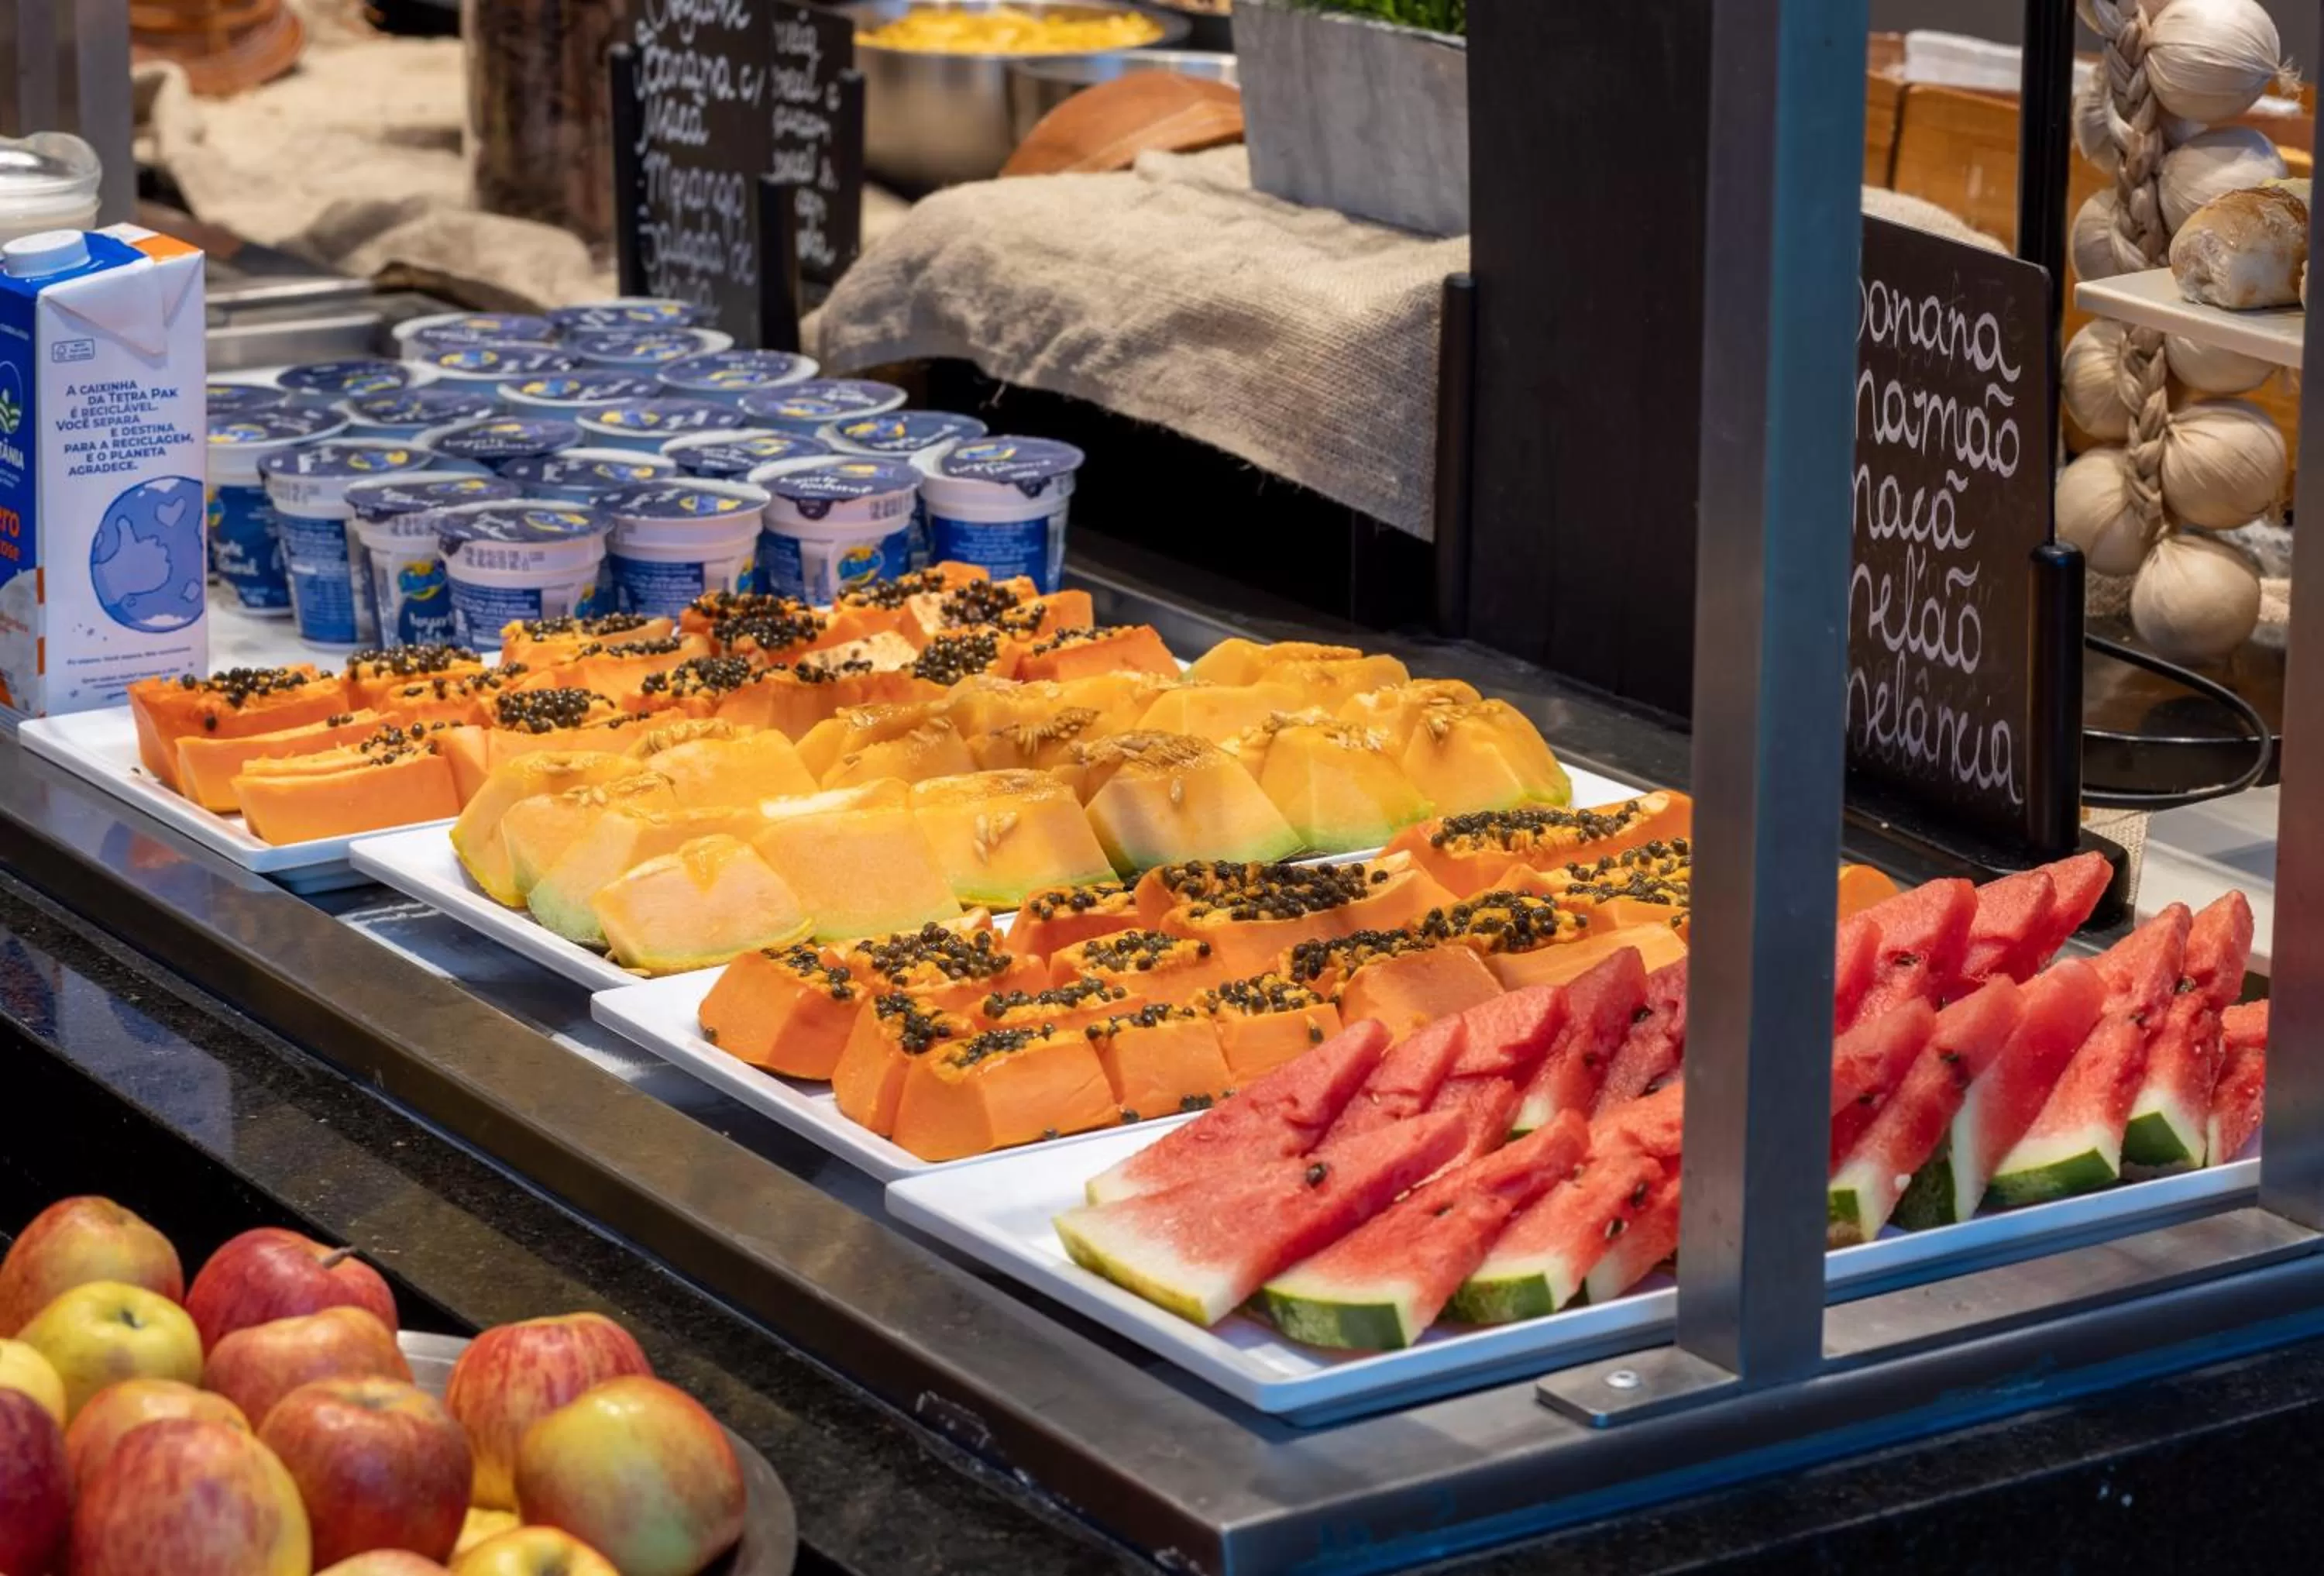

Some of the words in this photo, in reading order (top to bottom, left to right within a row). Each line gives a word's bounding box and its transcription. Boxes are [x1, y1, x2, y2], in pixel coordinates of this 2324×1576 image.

[66, 384, 77, 397] A
[80, 380, 138, 395] CAIXINHA
[88, 394, 105, 406] DA
[109, 391, 147, 404] TETRA
[151, 387, 178, 398] PAK
[70, 406, 78, 418] É
[56, 417, 90, 432] VOCÊ
[93, 415, 140, 428] SEPARA
[110, 428, 119, 438] E
[122, 422, 175, 436] DESTINA
[64, 441, 97, 454] PARA
[100, 439, 109, 449] A
[112, 433, 195, 449] RECICLAGEM,
[86, 452, 95, 463] E
[97, 452, 106, 462] O
[110, 446, 167, 459] PLANETA
[68, 460, 139, 477] AGRADECE.
